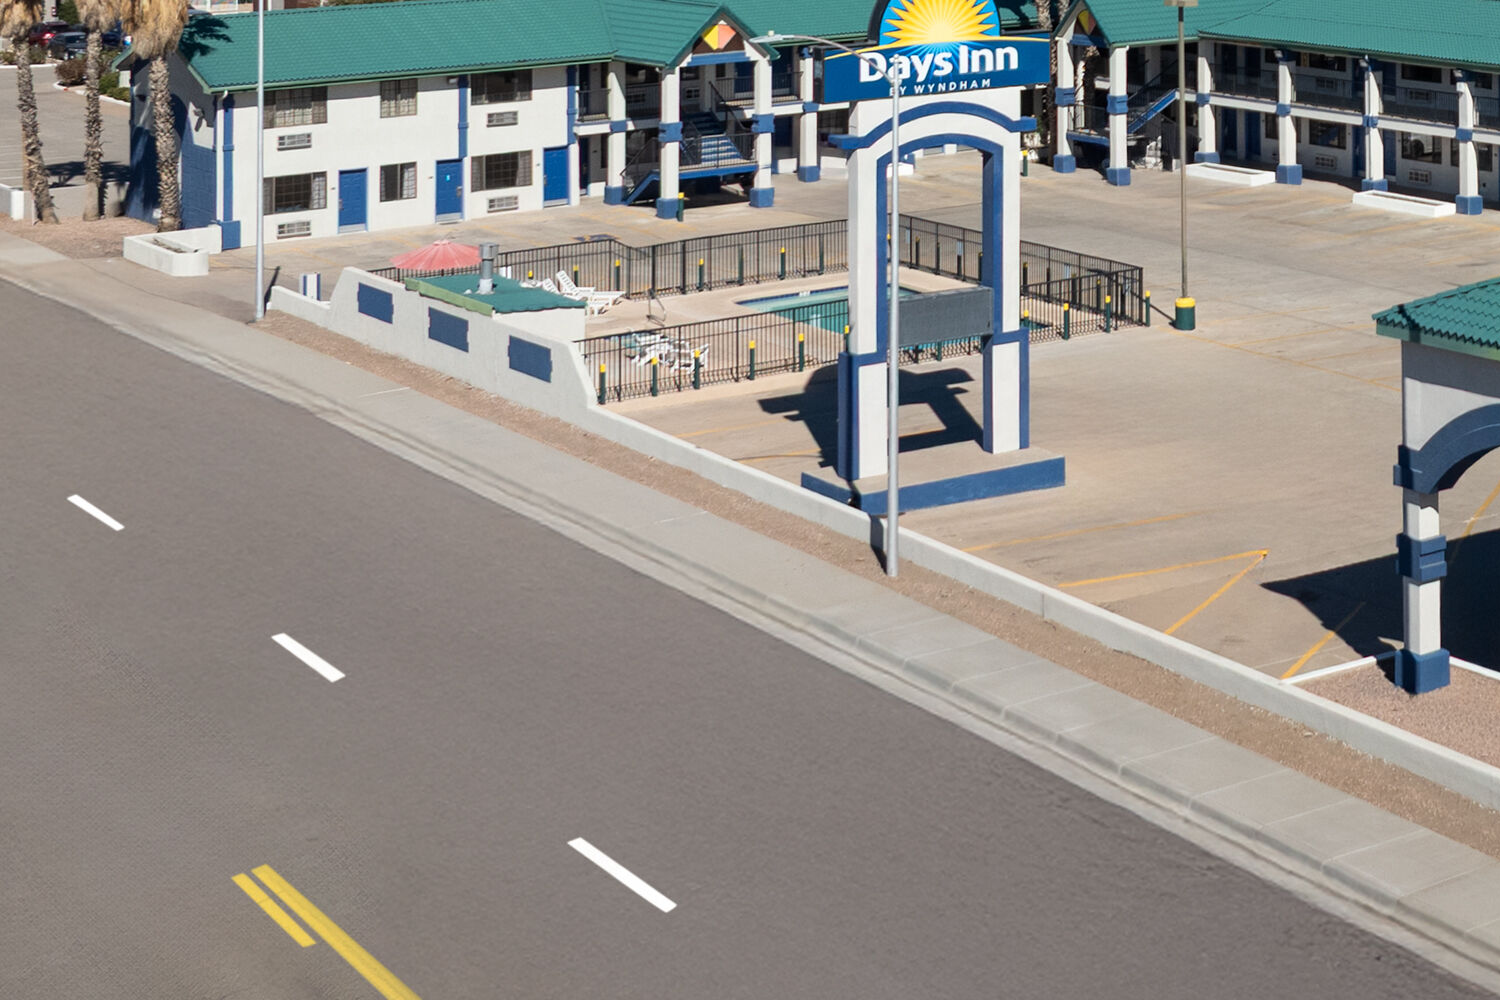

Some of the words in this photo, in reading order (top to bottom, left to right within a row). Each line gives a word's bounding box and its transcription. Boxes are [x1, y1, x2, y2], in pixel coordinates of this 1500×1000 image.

[859, 50, 953, 83] Days
[959, 45, 1018, 74] Inn
[914, 78, 991, 94] WYNDHAM
